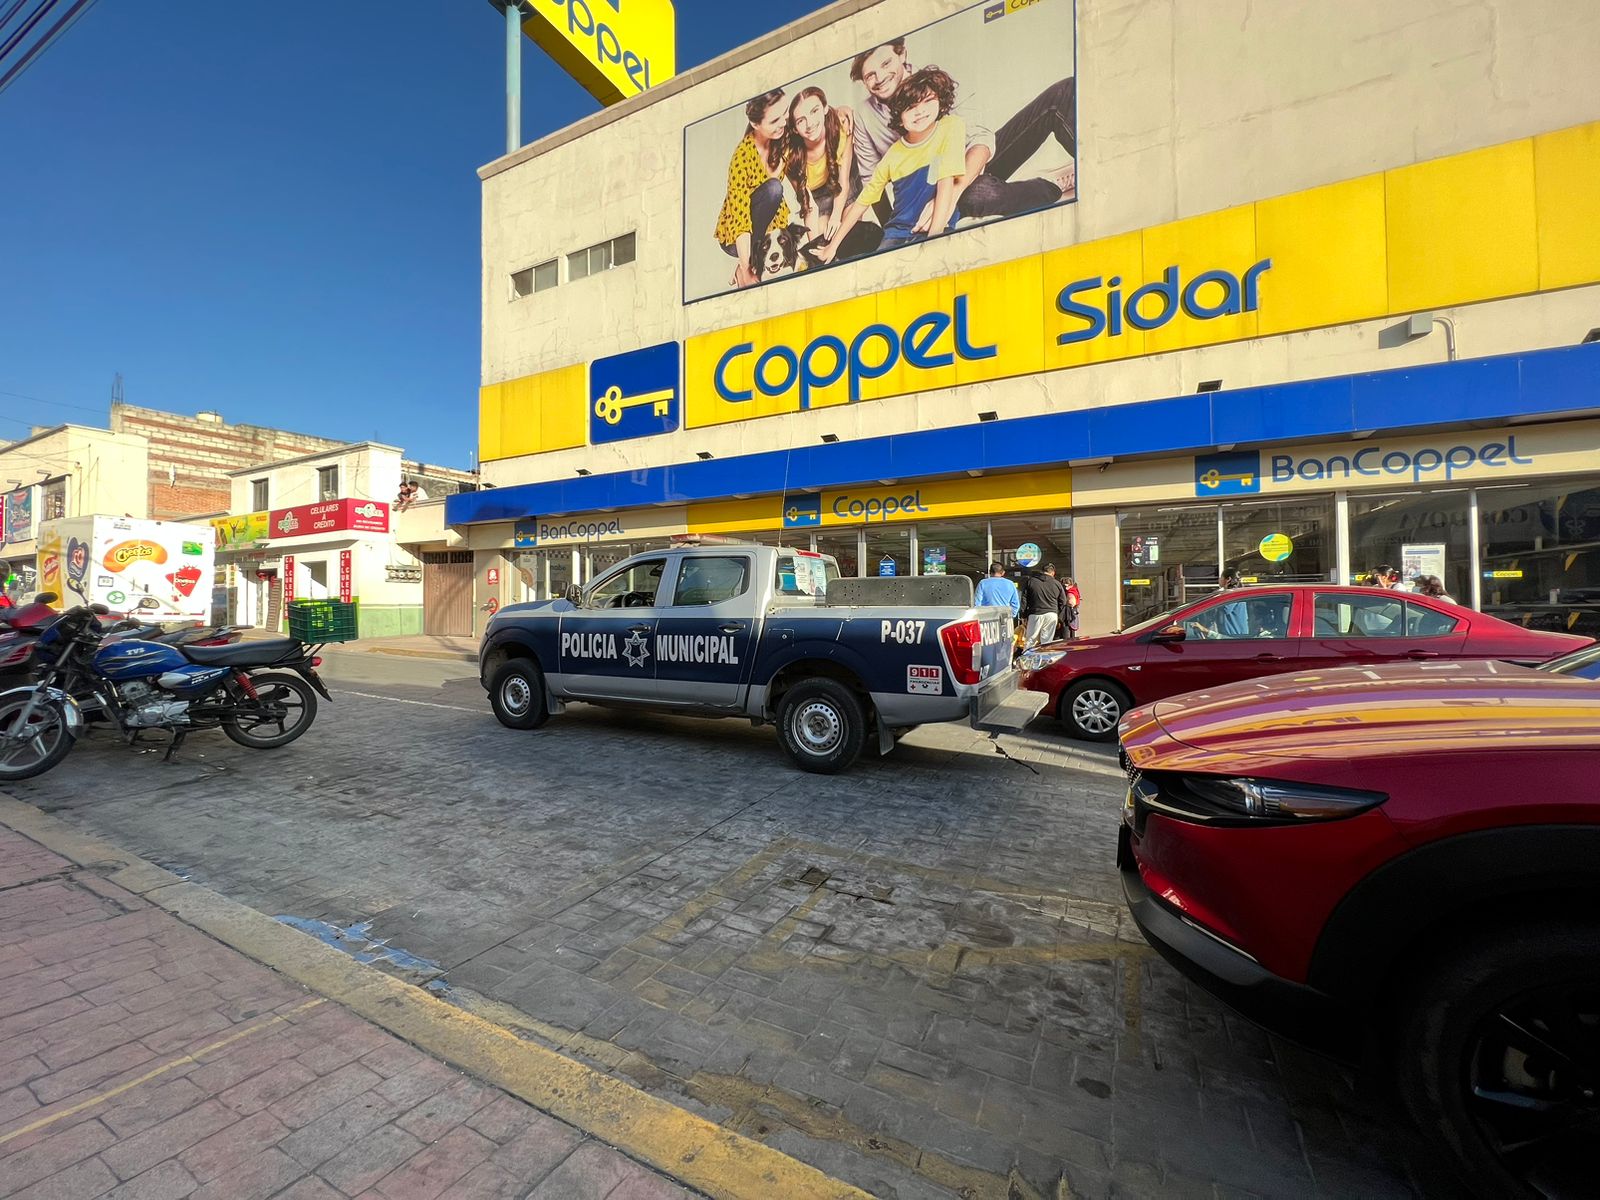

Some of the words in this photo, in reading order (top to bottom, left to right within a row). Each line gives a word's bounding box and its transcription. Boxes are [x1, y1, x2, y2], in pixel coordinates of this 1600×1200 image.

[553, 0, 650, 92] ppel
[714, 293, 997, 411] Coppel
[1055, 257, 1272, 346] Sidar
[1271, 435, 1532, 484] BanCoppel
[310, 504, 339, 514] CELULARES
[833, 489, 928, 523] Coppel
[541, 517, 624, 541] BanCoppel
[561, 632, 618, 659] POLICIA
[656, 634, 739, 665] MUNICIPAL
[881, 620, 926, 644] P-037
[911, 668, 937, 677] 911
